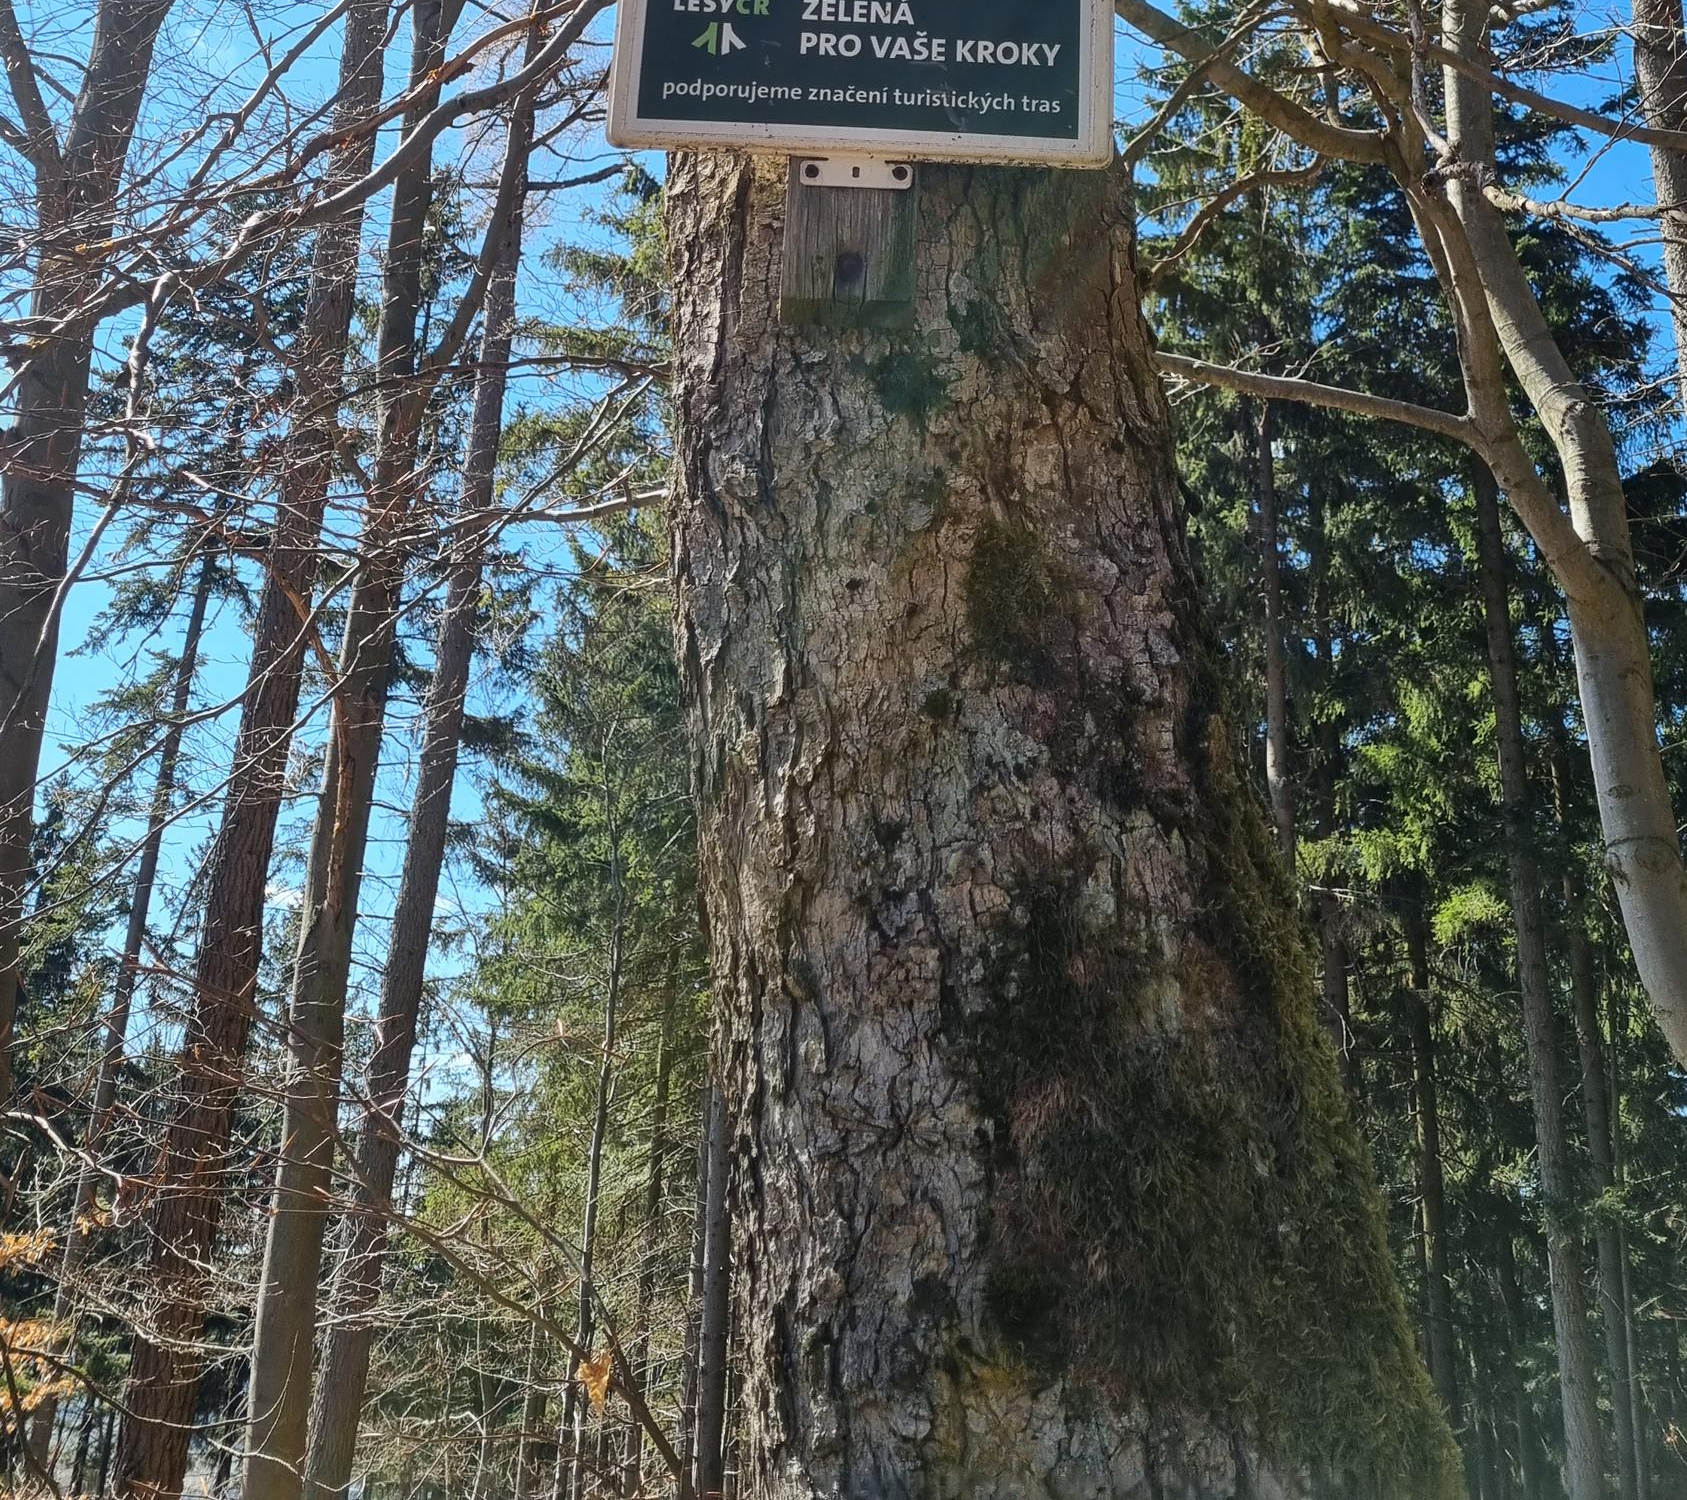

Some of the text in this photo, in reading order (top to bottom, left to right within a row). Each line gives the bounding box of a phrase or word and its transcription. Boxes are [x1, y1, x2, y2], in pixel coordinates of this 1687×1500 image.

[800, 32, 1061, 67] PRO VAŠE KROKY
[662, 80, 1061, 115] podporujeme značení turistických tras
